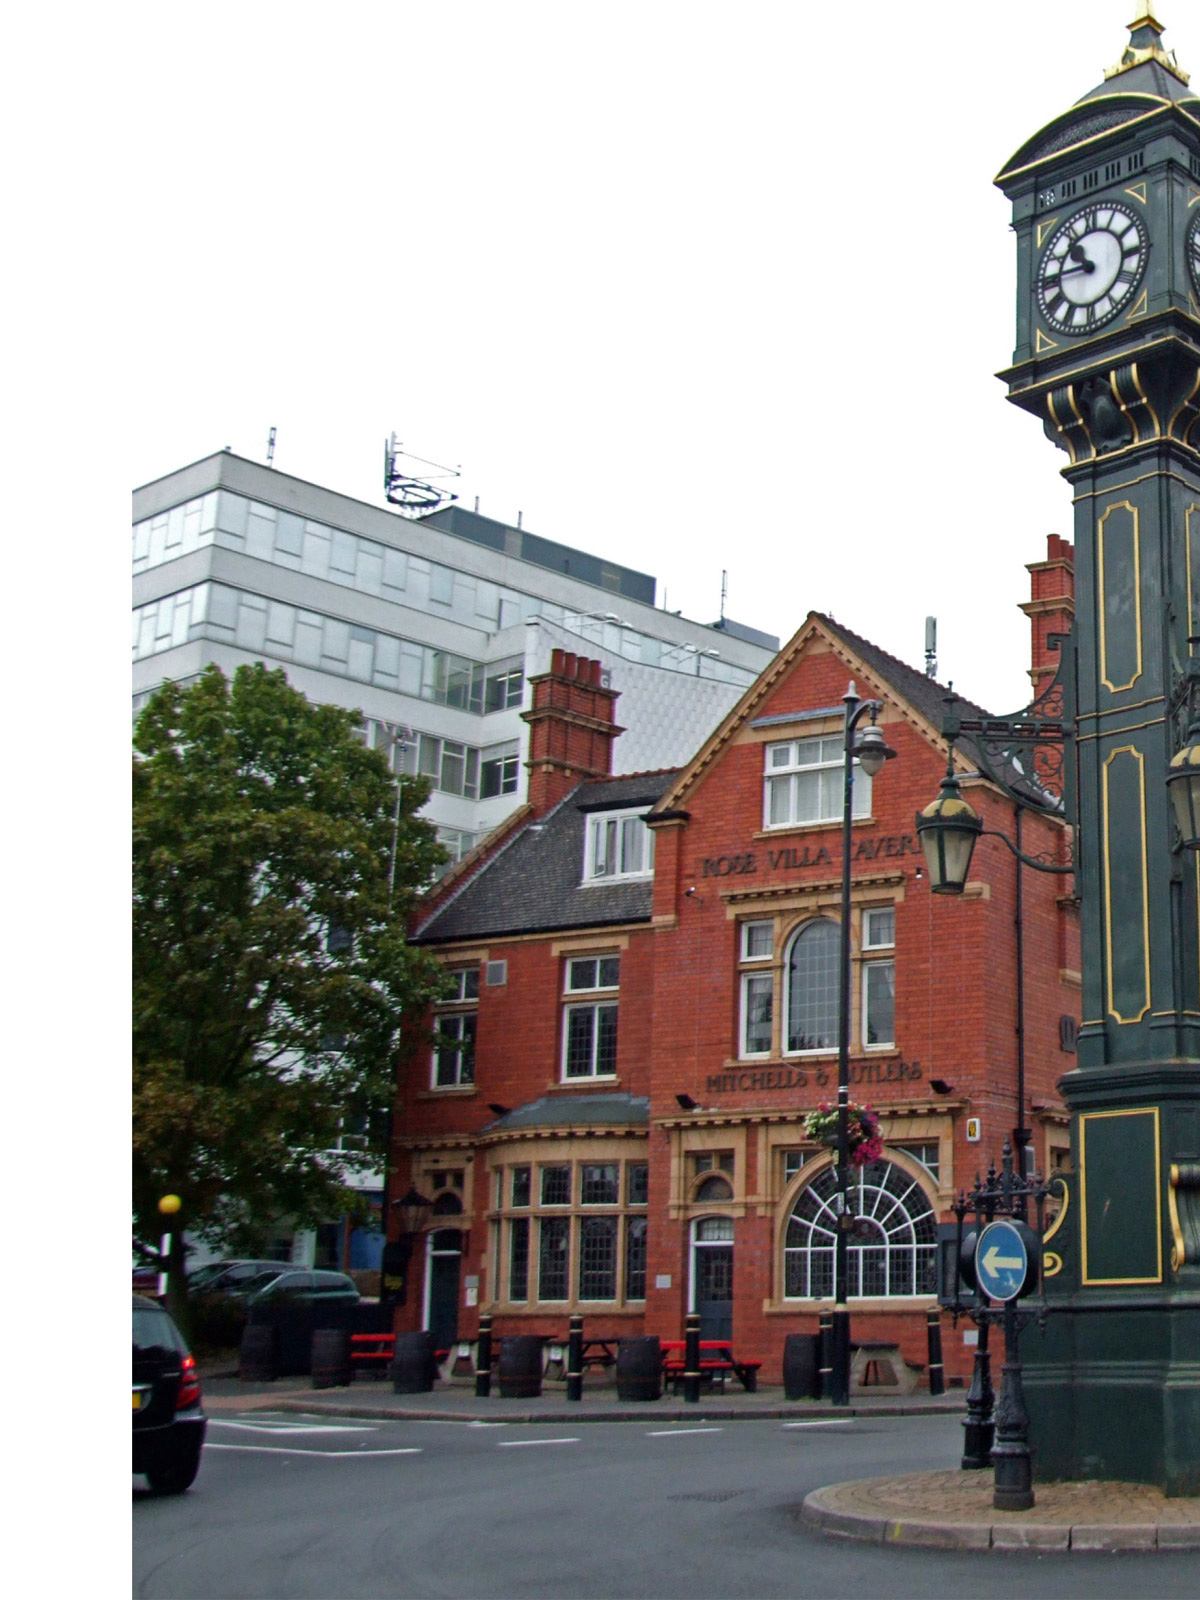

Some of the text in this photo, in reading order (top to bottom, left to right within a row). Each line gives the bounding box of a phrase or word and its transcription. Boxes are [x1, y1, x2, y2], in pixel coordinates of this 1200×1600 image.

[702, 833, 923, 878] ROSE VILLA AVER
[705, 1061, 923, 1093] MITCHELLS & UTLERS
